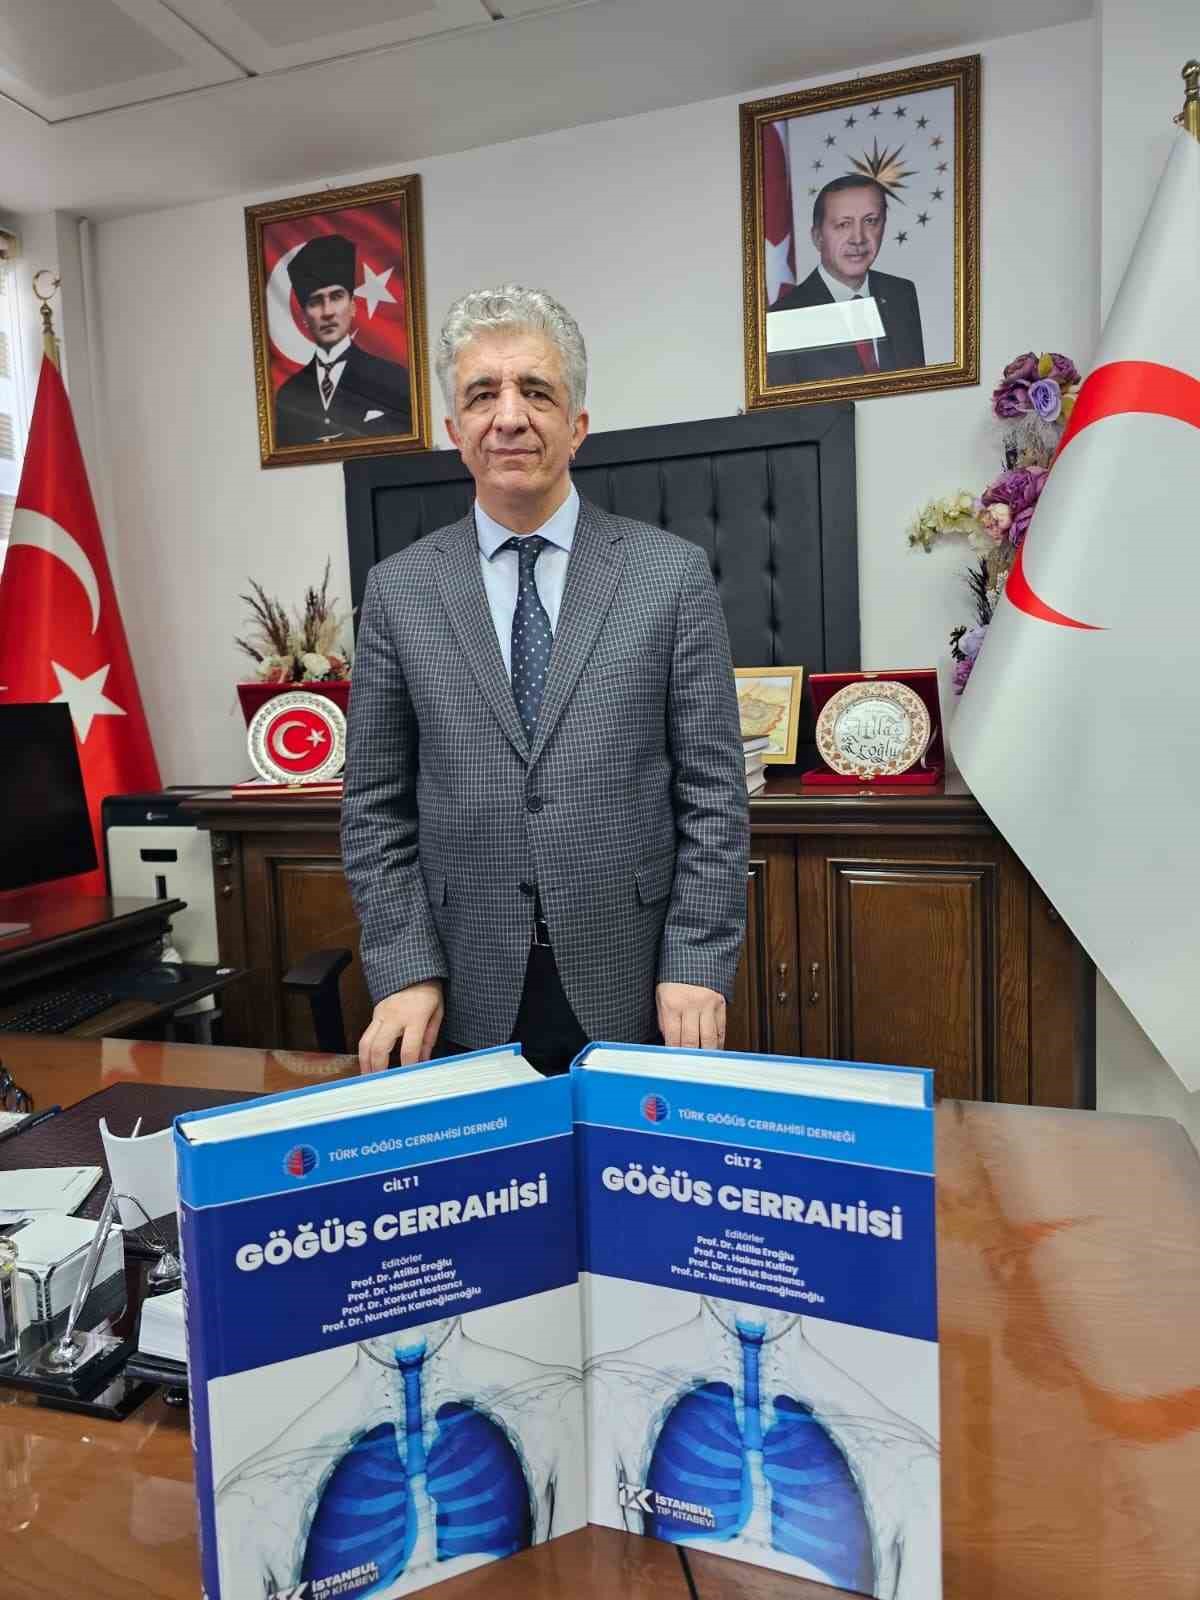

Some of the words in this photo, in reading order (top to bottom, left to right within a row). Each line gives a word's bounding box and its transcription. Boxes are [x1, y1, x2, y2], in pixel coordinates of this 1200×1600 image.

[328, 1146, 359, 1162] TÜRK
[361, 1137, 403, 1156] GÖĞÜS
[404, 1127, 461, 1147] CERRAHİSİ
[463, 1116, 508, 1136] DERNEĞİ
[678, 1107, 706, 1122] TÜRK
[707, 1112, 745, 1128] GÖĞÜS
[747, 1118, 805, 1137] CERRAHİSİ
[807, 1126, 856, 1144] DERNEĞİ
[724, 1152, 752, 1168] CİLT
[753, 1158, 762, 1169] 2
[383, 1177, 411, 1193] CİLT
[413, 1175, 420, 1187] 1
[601, 1163, 713, 1206] GÖĞÜS
[718, 1185, 903, 1240] CERRAHİSİ
[235, 1217, 368, 1271] GÖĞÜS
[373, 1172, 549, 1242] CERRAHİSİ
[725, 1229, 765, 1244] Editörler
[381, 1253, 423, 1270] Editörler
[694, 1246, 715, 1258] Prof.
[717, 1251, 731, 1261] Dr.
[732, 1254, 764, 1267] Hakan
[765, 1260, 799, 1275] Kutlay
[697, 1235, 720, 1247] Prof.
[720, 1240, 734, 1250] Dr.
[736, 1242, 761, 1256] Atilla
[762, 1247, 795, 1262] Eroğlu
[347, 1288, 372, 1303] Prof.
[373, 1286, 388, 1297] Dr.
[389, 1278, 423, 1293] Hakan
[423, 1269, 457, 1284] Kutlay
[351, 1276, 375, 1289] Prof.
[376, 1273, 392, 1284] Dr.
[393, 1266, 419, 1280] Atilla
[421, 1258, 453, 1273] Eroğlu
[671, 1265, 693, 1277] Prof.
[693, 1269, 708, 1280] Dr.
[709, 1272, 749, 1288] Nurettin
[688, 1256, 711, 1269] Prof.
[711, 1262, 725, 1272] Dr.
[726, 1264, 760, 1279] Korkut
[761, 1270, 805, 1287] Bostancı
[322, 1320, 347, 1334] Prof.
[348, 1317, 364, 1328] Dr.
[364, 1305, 408, 1324] Nurettin
[408, 1286, 482, 1312] Karaoğlanoğlu
[342, 1302, 366, 1316] Prof.
[367, 1300, 382, 1311] Dr.
[383, 1290, 418, 1306] Korkut
[419, 1279, 463, 1297] Bostancı
[655, 1491, 715, 1518] İSTANBUL
[656, 1505, 672, 1516] TIP
[672, 1509, 716, 1528] KİTABEVİ
[311, 1561, 379, 1593] İSTANBUL
[313, 1588, 331, 1600] TIP
[332, 1571, 379, 1595] KİTABEVİ
